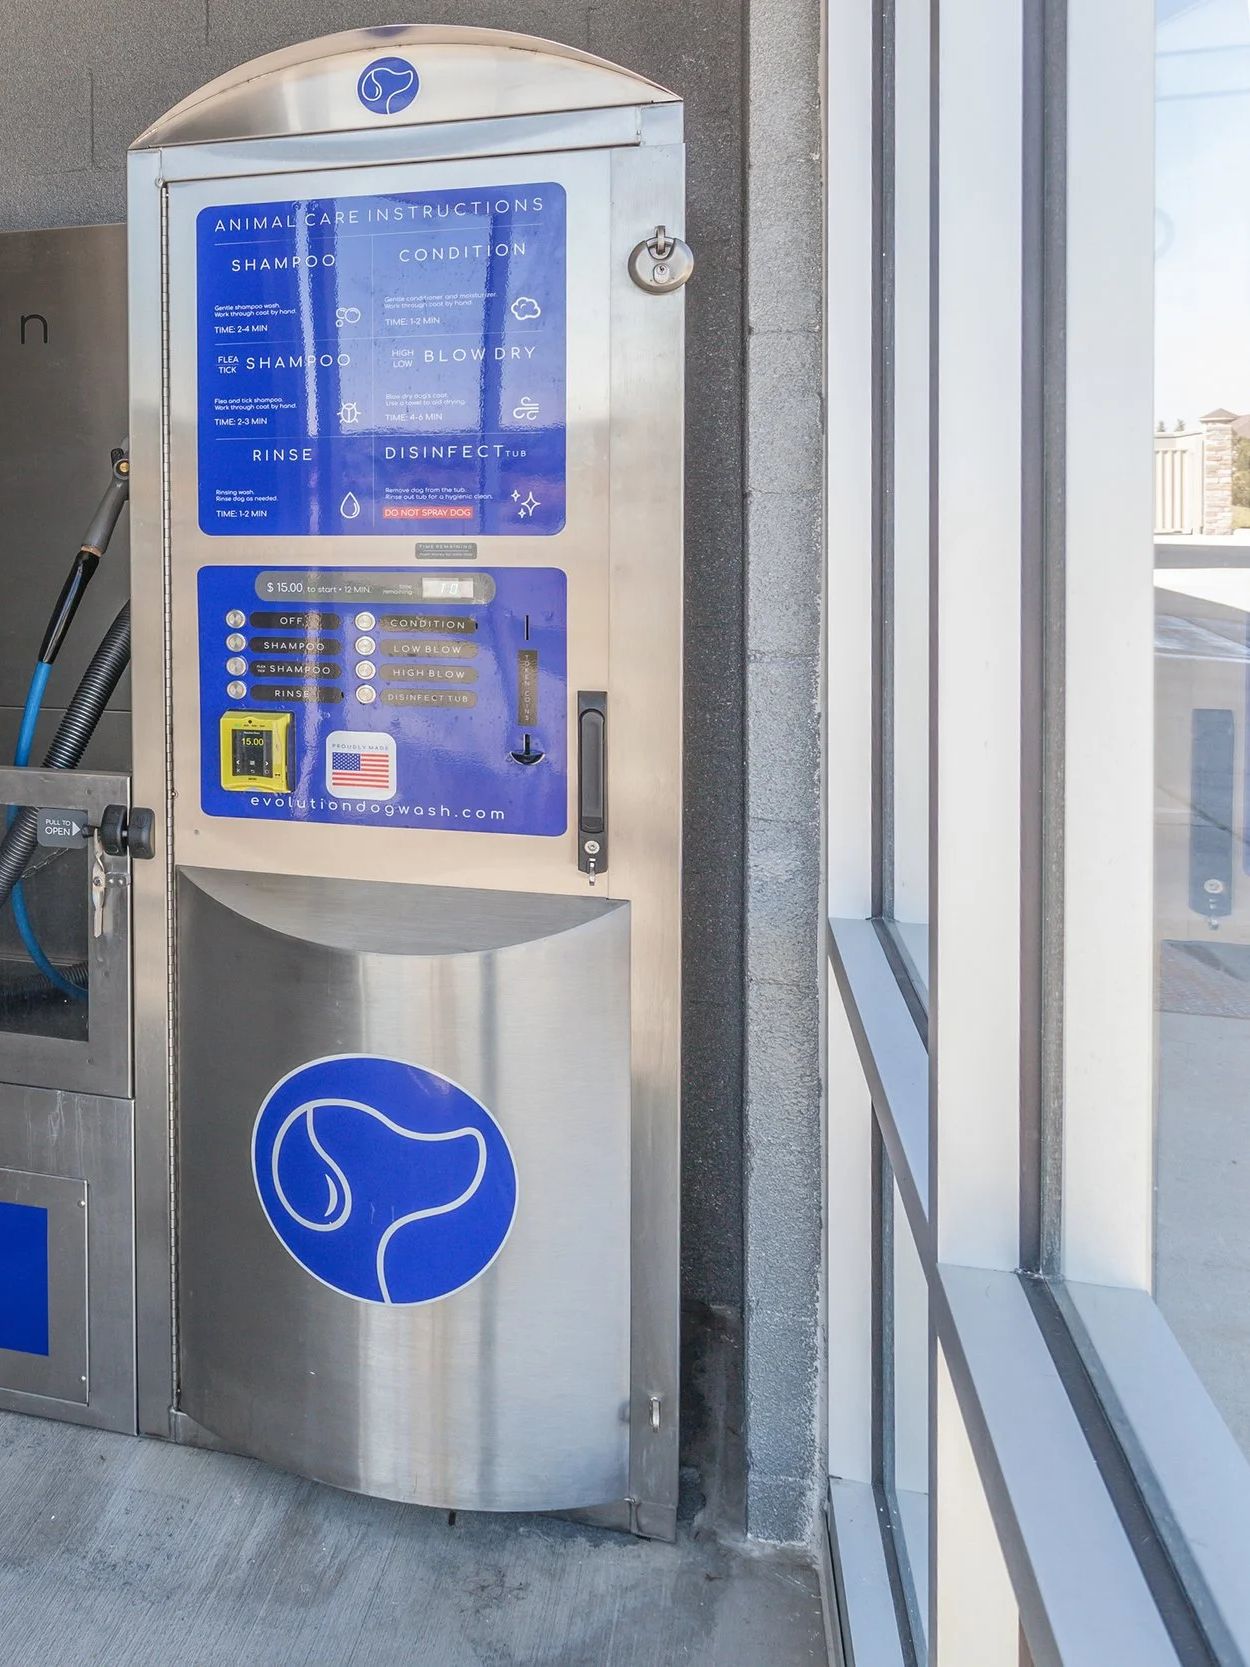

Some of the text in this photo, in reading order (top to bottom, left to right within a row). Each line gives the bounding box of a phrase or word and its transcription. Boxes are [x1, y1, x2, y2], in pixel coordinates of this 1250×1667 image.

[214, 197, 544, 233] ANIMAL CARE INSTRUCTIONS
[399, 242, 527, 263] CONDITION
[231, 253, 336, 273] SHAMPOO
[214, 304, 234, 312] Gentle
[401, 302, 428, 310] through
[230, 310, 255, 318] through
[385, 316, 440, 326] TIME: 1-2 MIN
[214, 324, 268, 334] TIME: 2-4 MIN
[391, 348, 414, 357] HIGH
[423, 346, 536, 363] BLOW DRY
[217, 355, 239, 364] FLEA
[246, 353, 351, 370] SHAMPOO
[392, 359, 413, 368] LOW
[218, 366, 237, 374] TICK
[230, 403, 255, 412] through
[214, 417, 268, 426] TIME: 2-3 MIN
[385, 413, 408, 421] TIME:
[409, 413, 424, 421] 4-6
[252, 447, 313, 462] RINSE
[385, 444, 527, 460] DISINFECT TUB
[232, 495, 245, 503] dog
[445, 493, 472, 501] hygienic
[216, 509, 268, 518] TIME: 1-2 MIN
[384, 508, 471, 517] DO NOT SPRAY DOG
[266, 582, 274, 593] $
[276, 582, 303, 593] 15.00
[279, 616, 303, 625] OFF
[390, 619, 465, 629] CONDITION
[263, 641, 325, 651] SHAMPOO
[393, 644, 462, 654] LOW BLOW
[269, 664, 331, 675] SHAMPOO
[392, 669, 465, 678] HIGH BLOW
[274, 689, 310, 698] RINSE
[387, 693, 468, 703] DISINFECT TUB
[241, 737, 264, 746] 15.00
[250, 795, 505, 820] evolutiondogwash.com
[45, 818, 71, 827] PULL TO
[45, 826, 71, 836] OPEN
